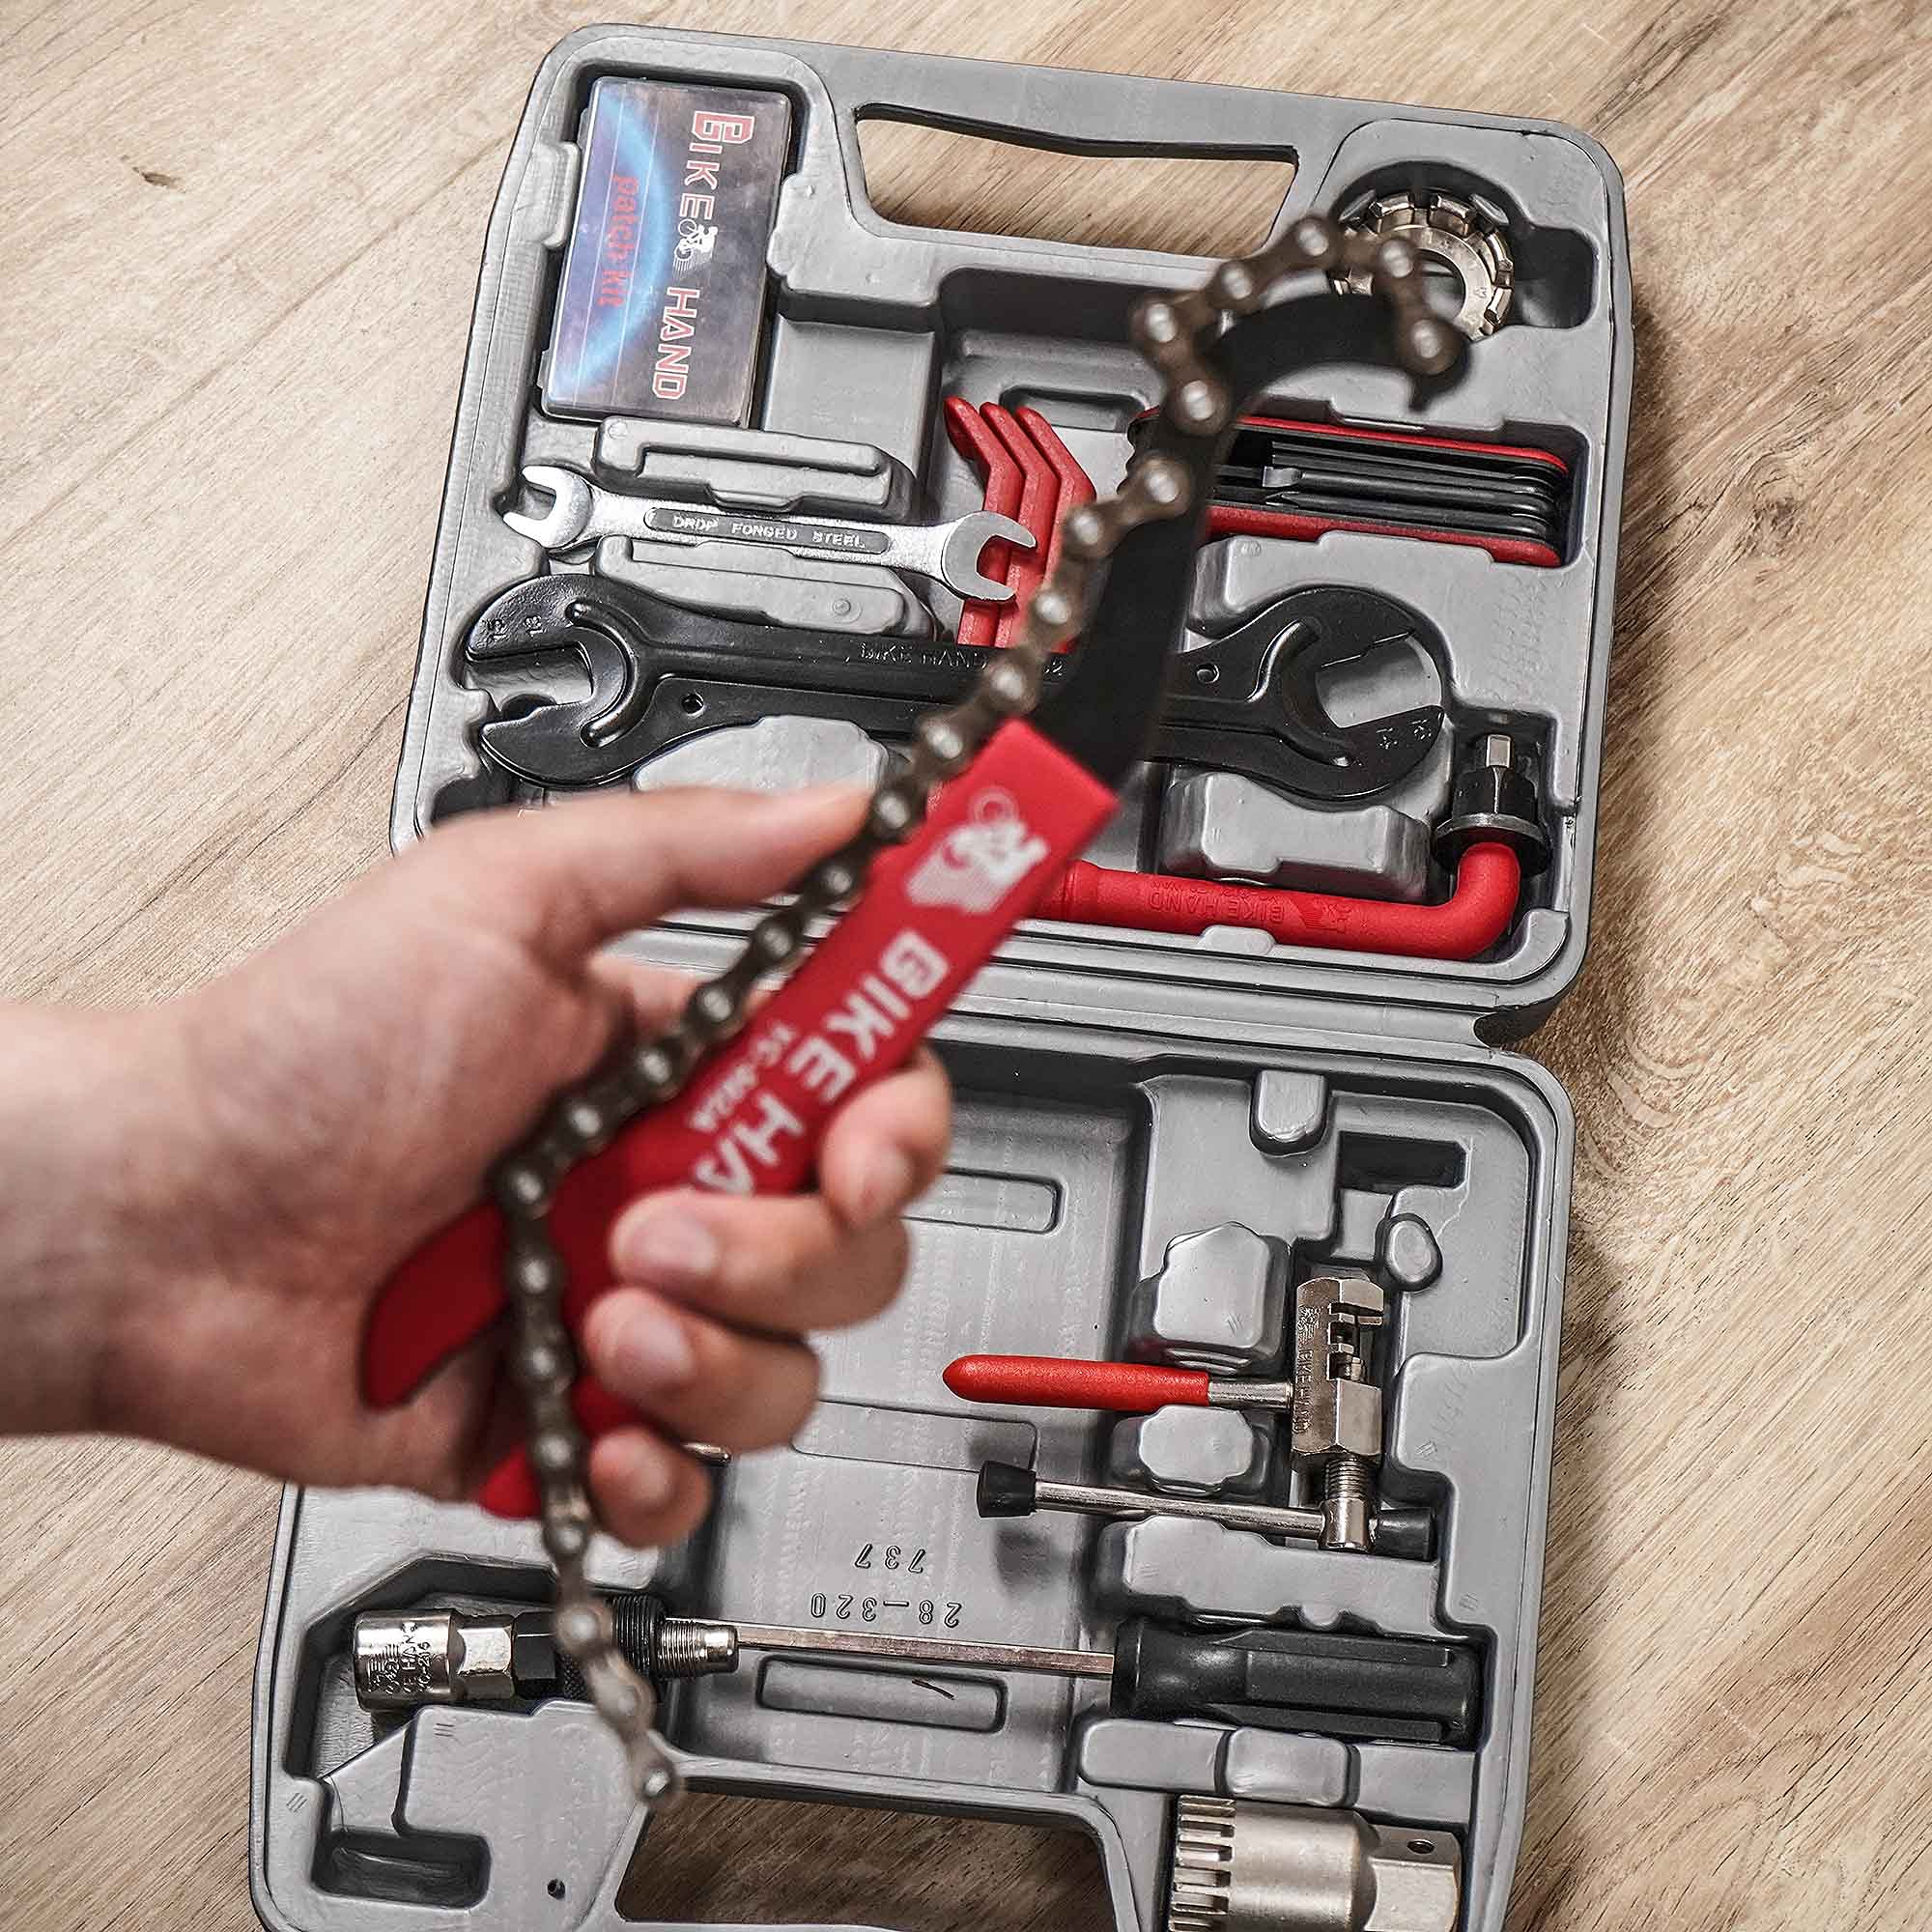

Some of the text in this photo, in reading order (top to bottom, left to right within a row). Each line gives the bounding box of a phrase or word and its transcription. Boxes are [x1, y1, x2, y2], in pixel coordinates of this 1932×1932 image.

[597, 172, 640, 308] patch kit
[651, 110, 755, 400] BIKE HAND
[672, 514, 867, 549] DROP FORGED STEEL
[1150, 891, 1220, 919] HAND
[1225, 895, 1286, 924] BIKE
[690, 927, 950, 1198] BIKE HA
[854, 1543, 926, 1574] 737
